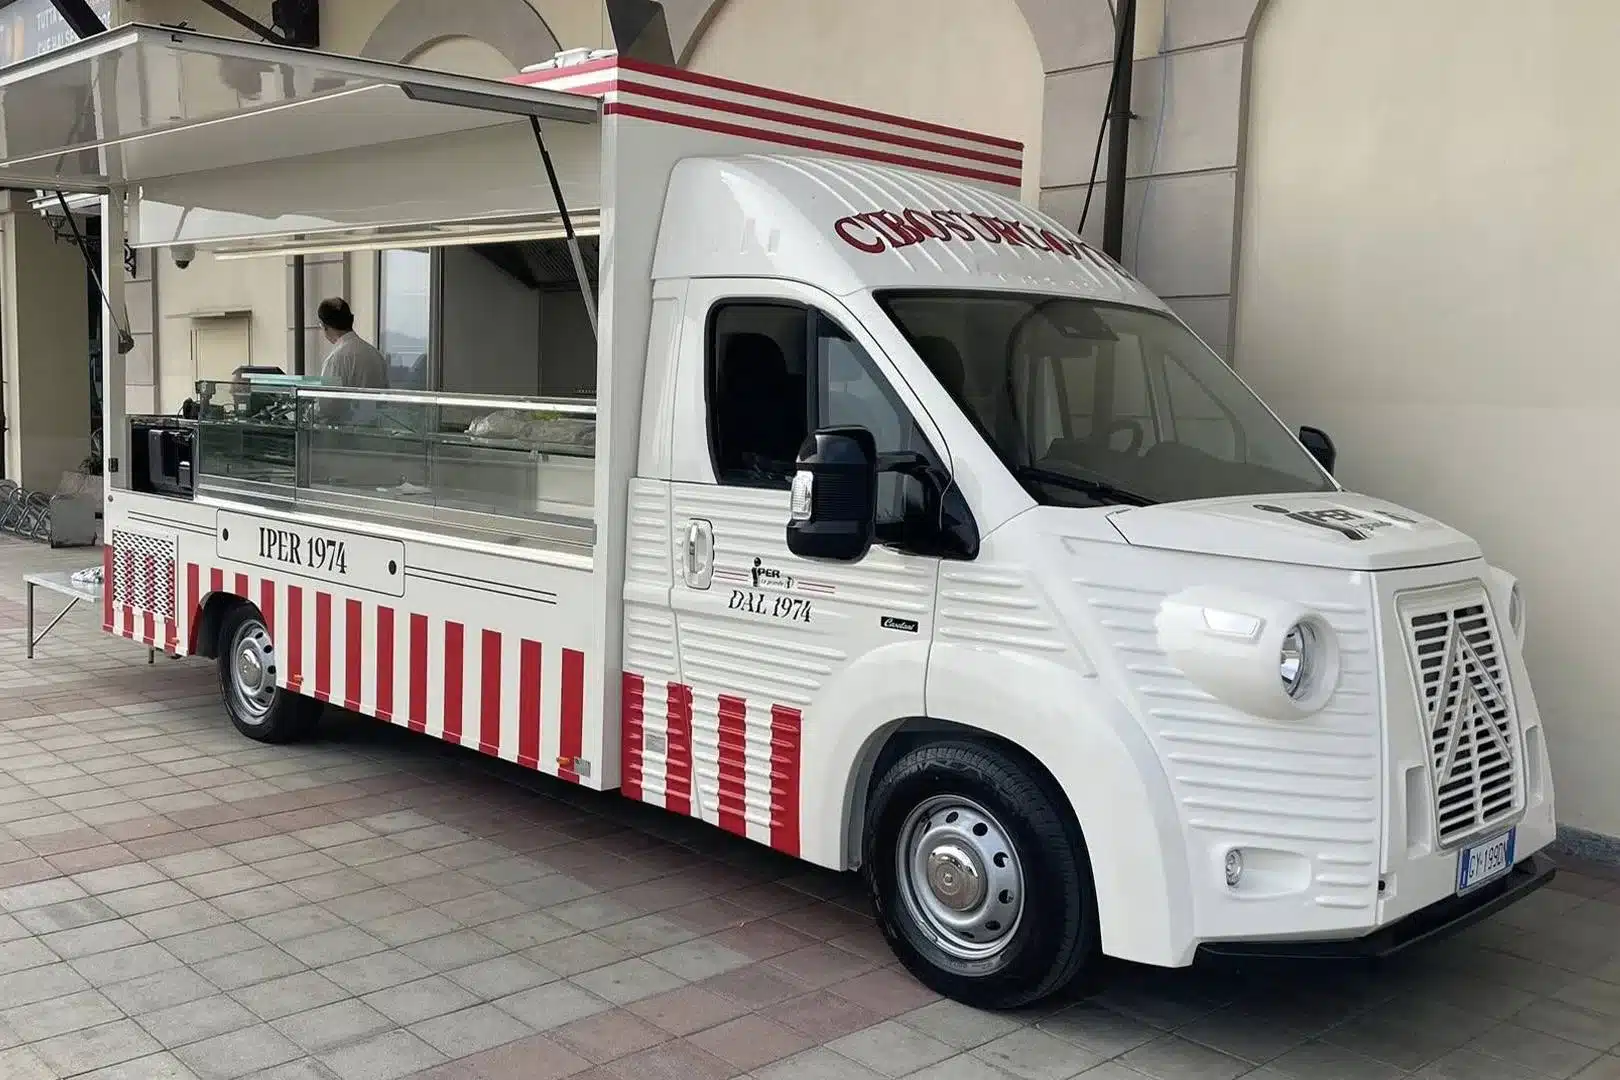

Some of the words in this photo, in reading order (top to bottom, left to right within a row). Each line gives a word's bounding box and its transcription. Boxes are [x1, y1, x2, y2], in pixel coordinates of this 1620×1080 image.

[259, 527, 301, 565] IPER
[307, 536, 347, 574] 1974
[728, 590, 766, 615] DAL
[772, 597, 812, 622] 1974
